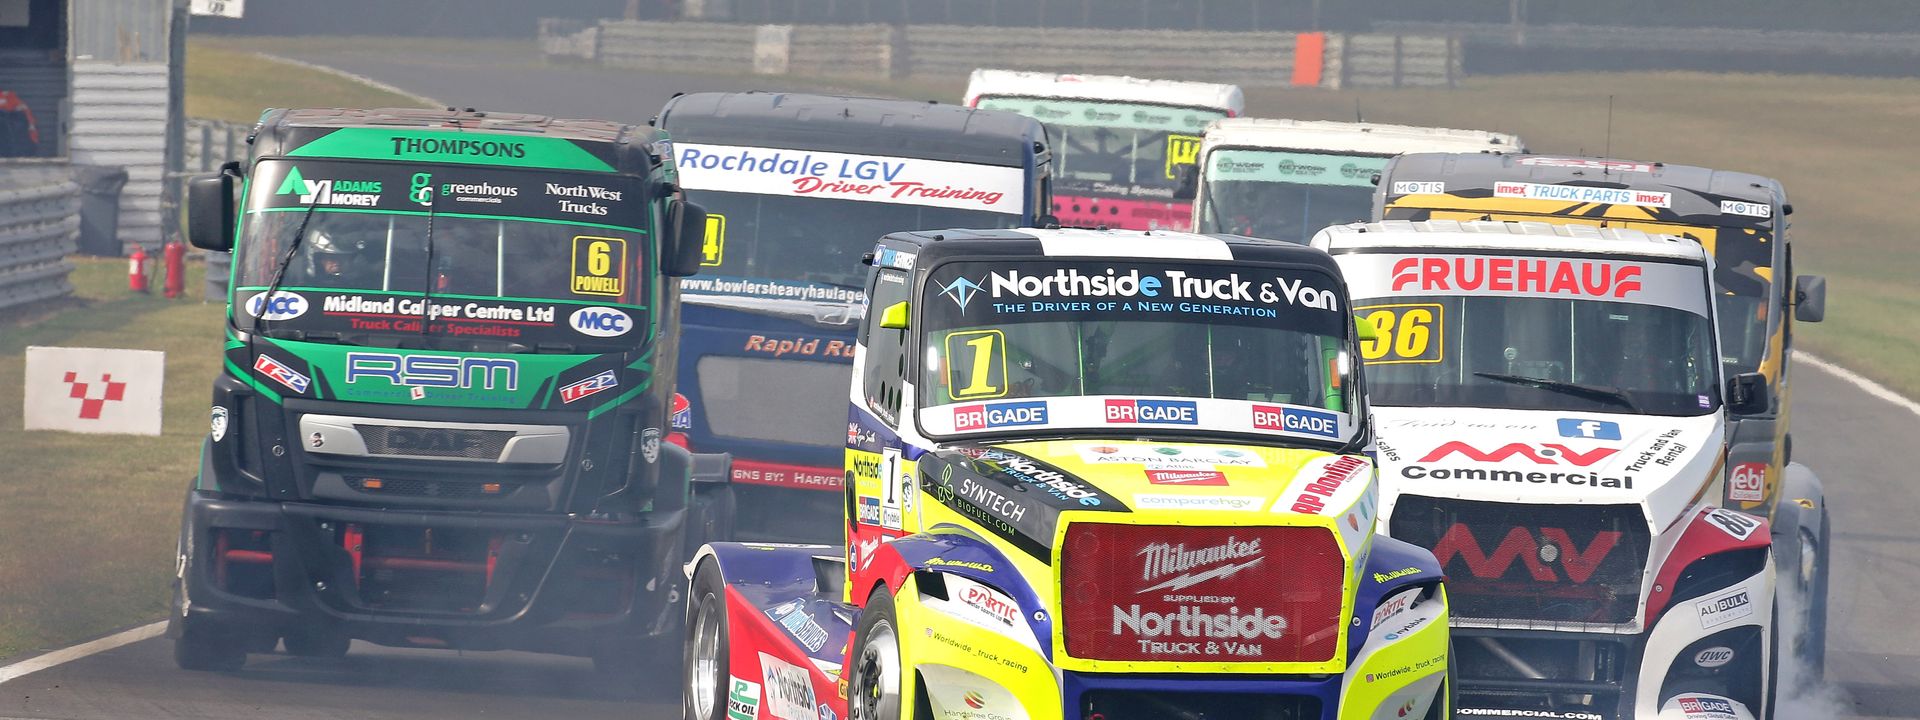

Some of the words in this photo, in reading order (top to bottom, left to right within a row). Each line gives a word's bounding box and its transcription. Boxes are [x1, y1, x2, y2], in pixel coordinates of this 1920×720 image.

[391, 137, 526, 159] THOMPSONS
[679, 148, 829, 177] Rochdale
[838, 159, 905, 182] LGV
[333, 180, 382, 193] ADAMS
[441, 182, 518, 197] greenhous
[791, 176, 885, 194] Driver
[890, 181, 1004, 205] Training
[1395, 183, 1442, 193] MOTIS
[1497, 184, 1527, 195] imex
[1533, 186, 1579, 199] TRUCK
[1582, 189, 1630, 203] PARTS
[1636, 192, 1666, 204] imex
[332, 193, 381, 206] MOREY
[559, 200, 608, 216] Trucks
[1723, 202, 1769, 216] MOTIS
[588, 241, 611, 276] 6
[575, 276, 620, 293] POWELL
[1392, 257, 1642, 298] FRUEHAUF
[990, 268, 1162, 298] Northside
[1165, 270, 1255, 302] Truck
[1259, 283, 1280, 303] &
[1276, 276, 1338, 312] Van
[254, 296, 300, 315] MCC
[323, 295, 394, 314] Midland
[465, 303, 523, 321] Centre
[527, 306, 555, 323] Ltd
[1122, 303, 1132, 311] A
[351, 319, 390, 330] Truck
[448, 324, 520, 337] Specialists
[578, 311, 625, 332] MCC
[745, 335, 820, 358] Rapid
[959, 334, 997, 396] 1
[562, 371, 615, 402] TRP
[955, 407, 1044, 428] BRIGADE
[1106, 403, 1195, 422] BRIGADE
[1254, 409, 1337, 434] BRIGADE
[1168, 457, 1252, 465] BARCLAY
[1625, 451, 1655, 473] Truck
[1650, 438, 1669, 452] and
[1664, 428, 1683, 440] Van
[1655, 443, 1687, 467] Rental
[888, 453, 896, 504] 1
[999, 457, 1101, 506] Northside
[1401, 466, 1633, 489] Commercial
[1729, 464, 1765, 492] febi
[960, 478, 1026, 523] SYNTECH
[1048, 487, 1069, 501] VAN
[1141, 497, 1251, 508] comparehgv
[860, 503, 880, 518] BRIGADE
[957, 499, 1016, 536] BIOFUEL.COM
[1136, 536, 1263, 581] Milwaukee
[968, 588, 1018, 621] PARTIC
[1163, 594, 1218, 603] SUPPLIED
[1113, 604, 1288, 639] Northside
[933, 632, 972, 653] Worldwide
[1138, 640, 1201, 654] TRUCK
[1205, 641, 1220, 655] &
[1224, 642, 1262, 656] VAN
[1698, 650, 1731, 663] gwc
[1375, 664, 1411, 681] Worldwide
[742, 704, 755, 716] OIL
[1682, 702, 1732, 713] BRIGADE
